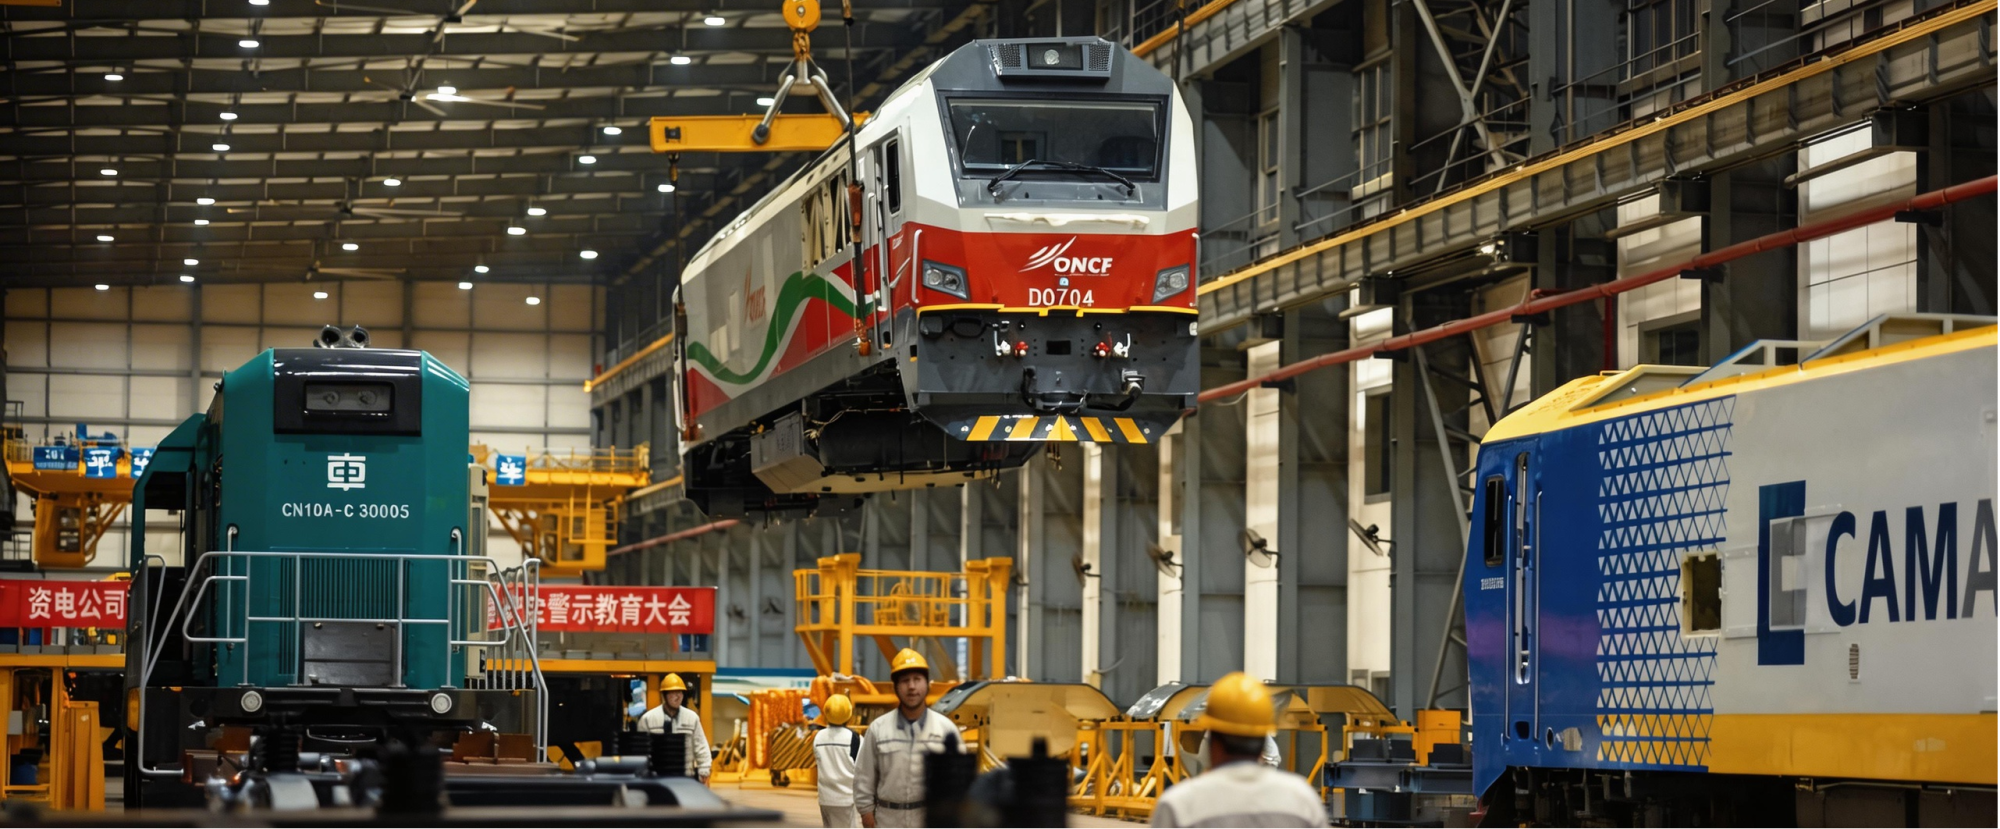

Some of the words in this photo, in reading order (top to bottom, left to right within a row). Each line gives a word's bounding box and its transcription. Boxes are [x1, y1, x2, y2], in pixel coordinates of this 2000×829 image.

[1054, 257, 1113, 274] ONCF
[282, 503, 354, 517] CN10A-C
[359, 504, 410, 519] 30005
[28, 586, 125, 620] 资电公司
